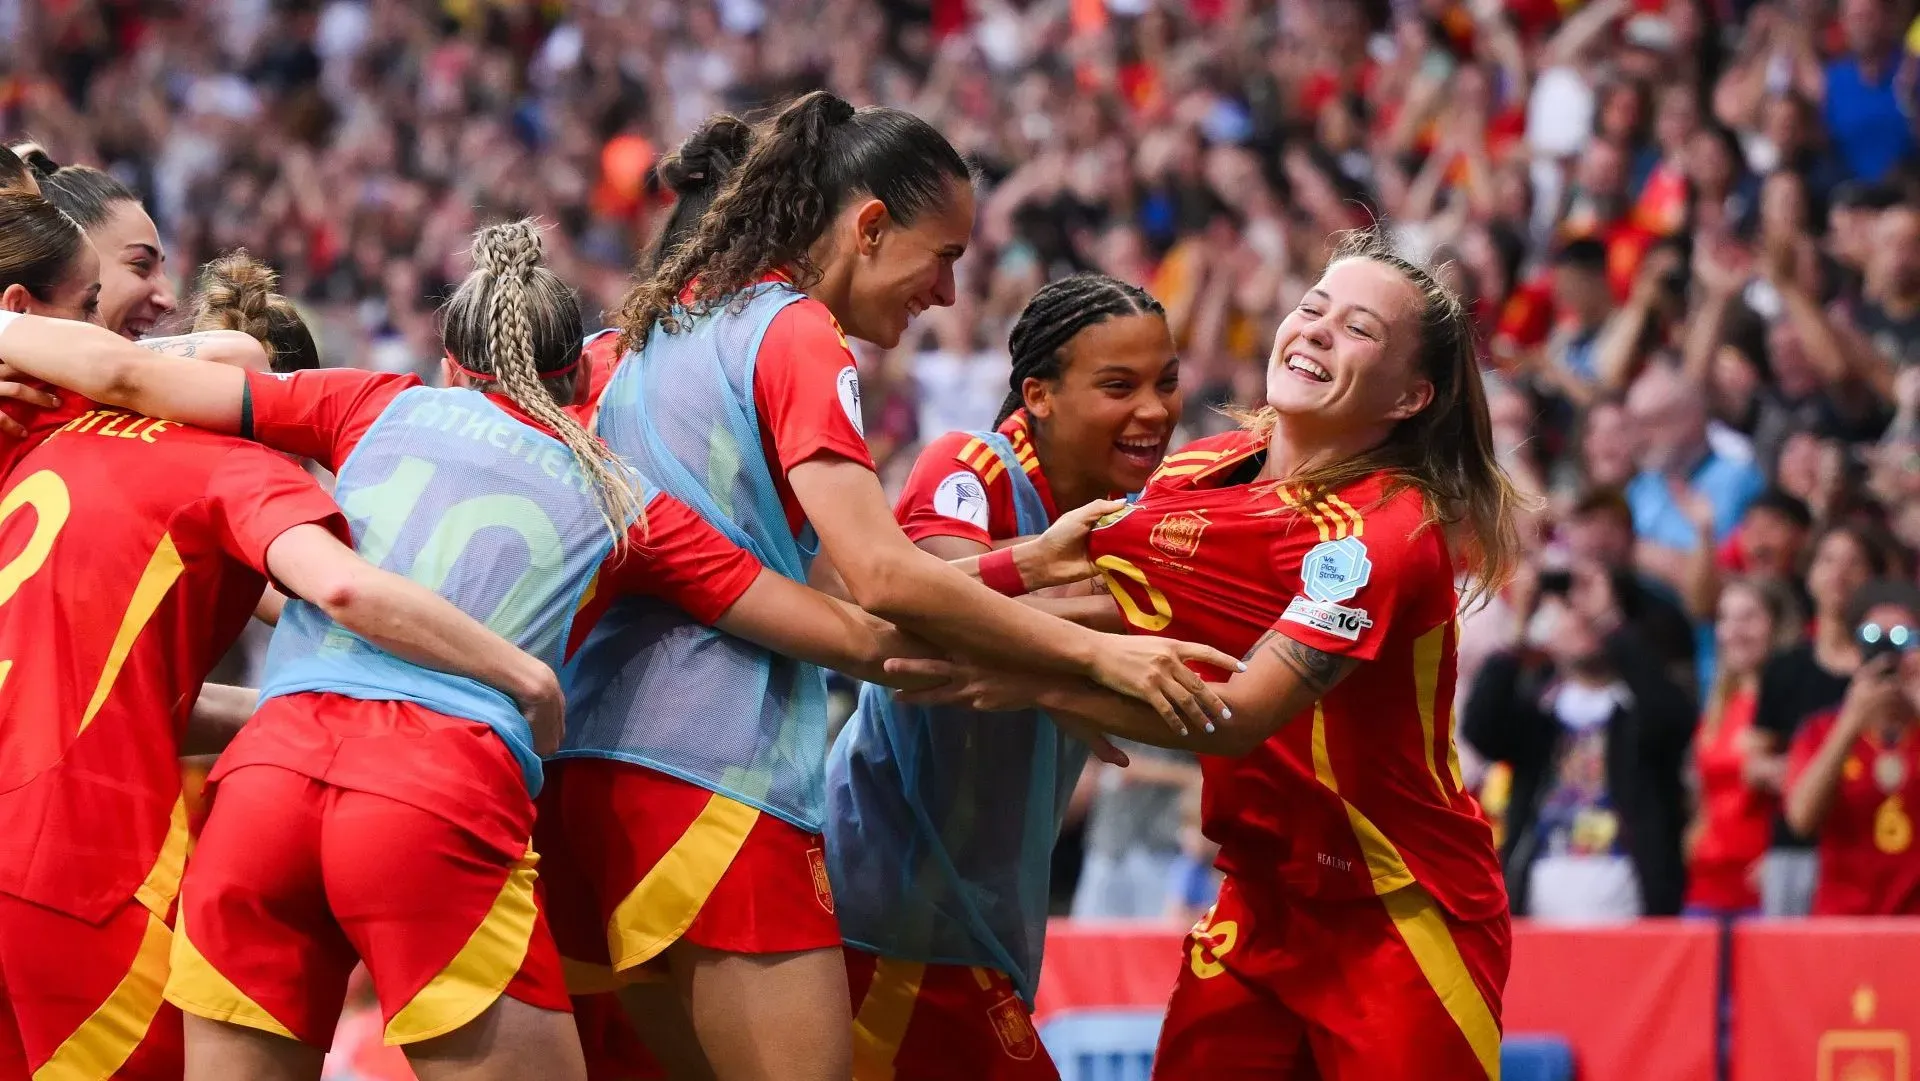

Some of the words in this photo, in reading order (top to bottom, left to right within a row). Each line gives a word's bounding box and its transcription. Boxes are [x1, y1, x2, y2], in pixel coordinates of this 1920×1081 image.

[318, 455, 564, 655] 10
[1323, 555, 1334, 563] We
[1319, 571, 1345, 582] Strong
[1338, 612, 1360, 631] 10
